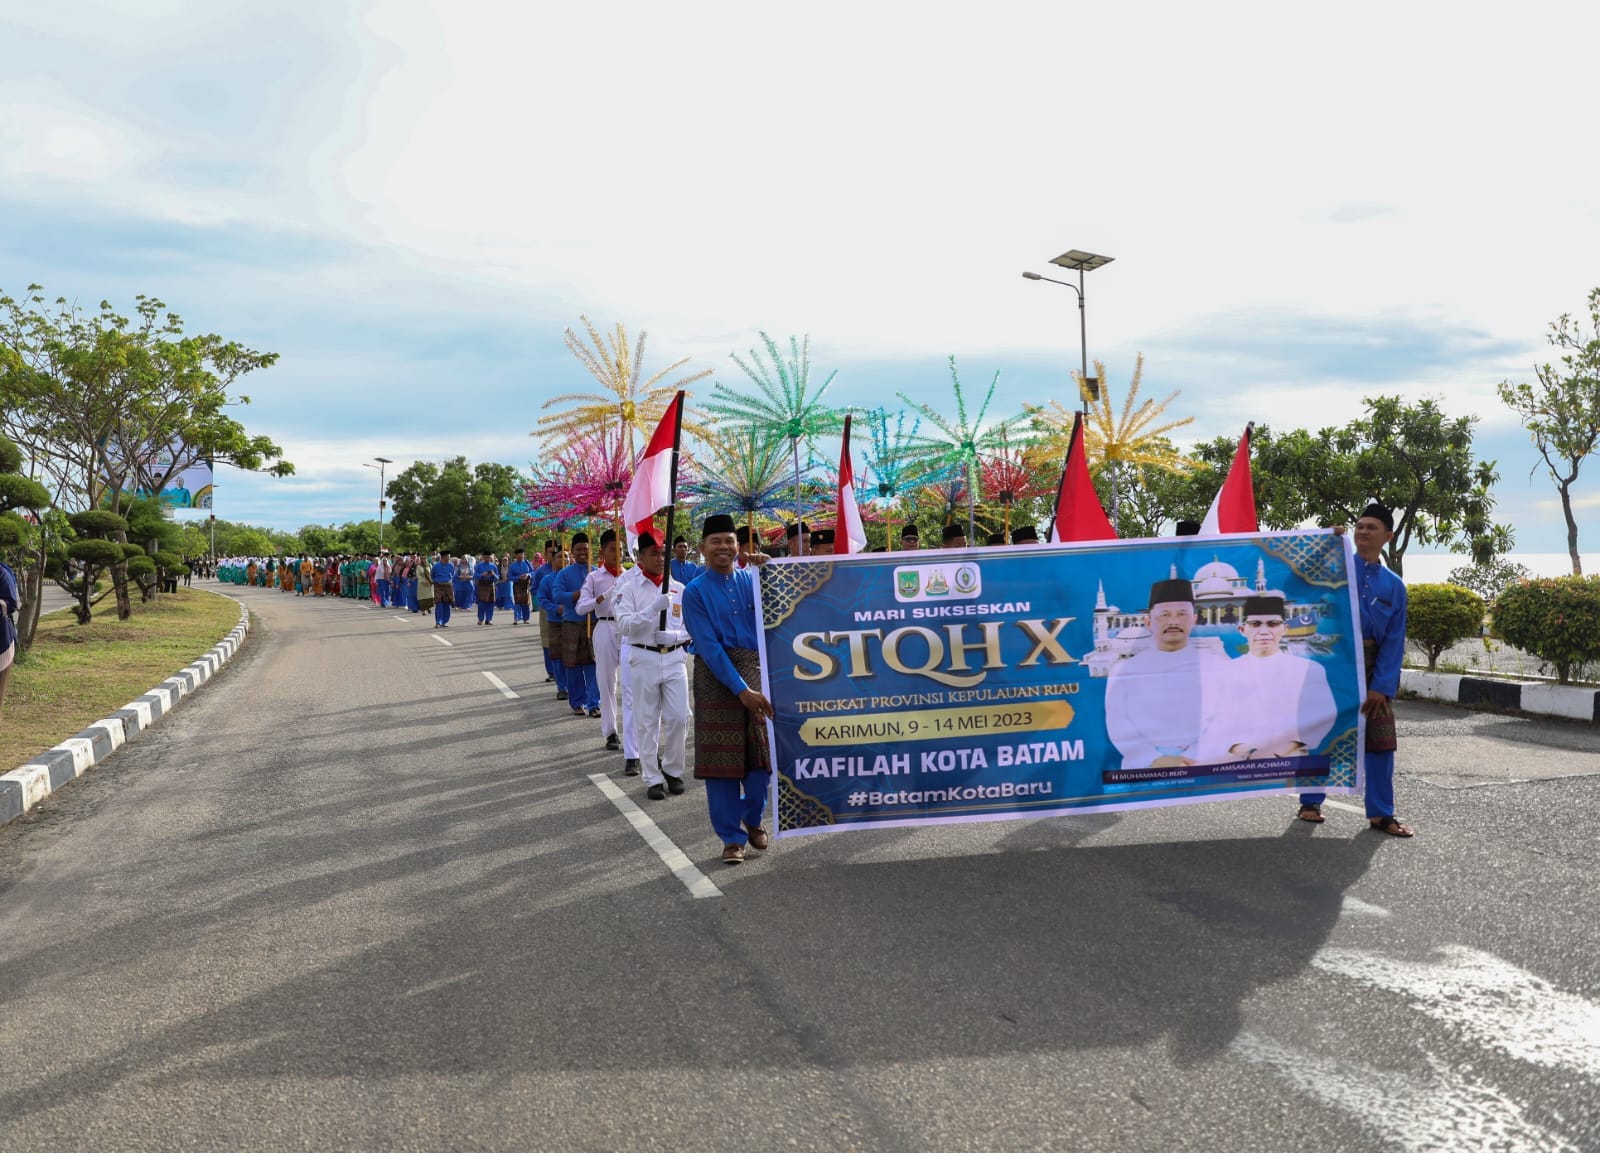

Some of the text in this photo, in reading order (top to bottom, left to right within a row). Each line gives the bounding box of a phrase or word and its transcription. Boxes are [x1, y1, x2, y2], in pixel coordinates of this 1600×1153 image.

[854, 602, 1031, 622] MARI SUKSESKAN
[792, 617, 1080, 688] STQH X
[795, 682, 1080, 713] TINGKAT PROVINSI KEPULAUAN RIAU
[815, 721, 905, 740] KARIMUN,
[908, 720, 919, 734] 9
[934, 718, 954, 732] 14
[958, 715, 988, 730] MEI
[992, 711, 1033, 728] 2023
[795, 739, 1085, 780] KAFILAH KOTA BATAM
[1257, 759, 1291, 769] ACHMAD
[1120, 770, 1168, 781] MUHAMMAD
[847, 781, 1053, 807] #BatamKotaBaru
